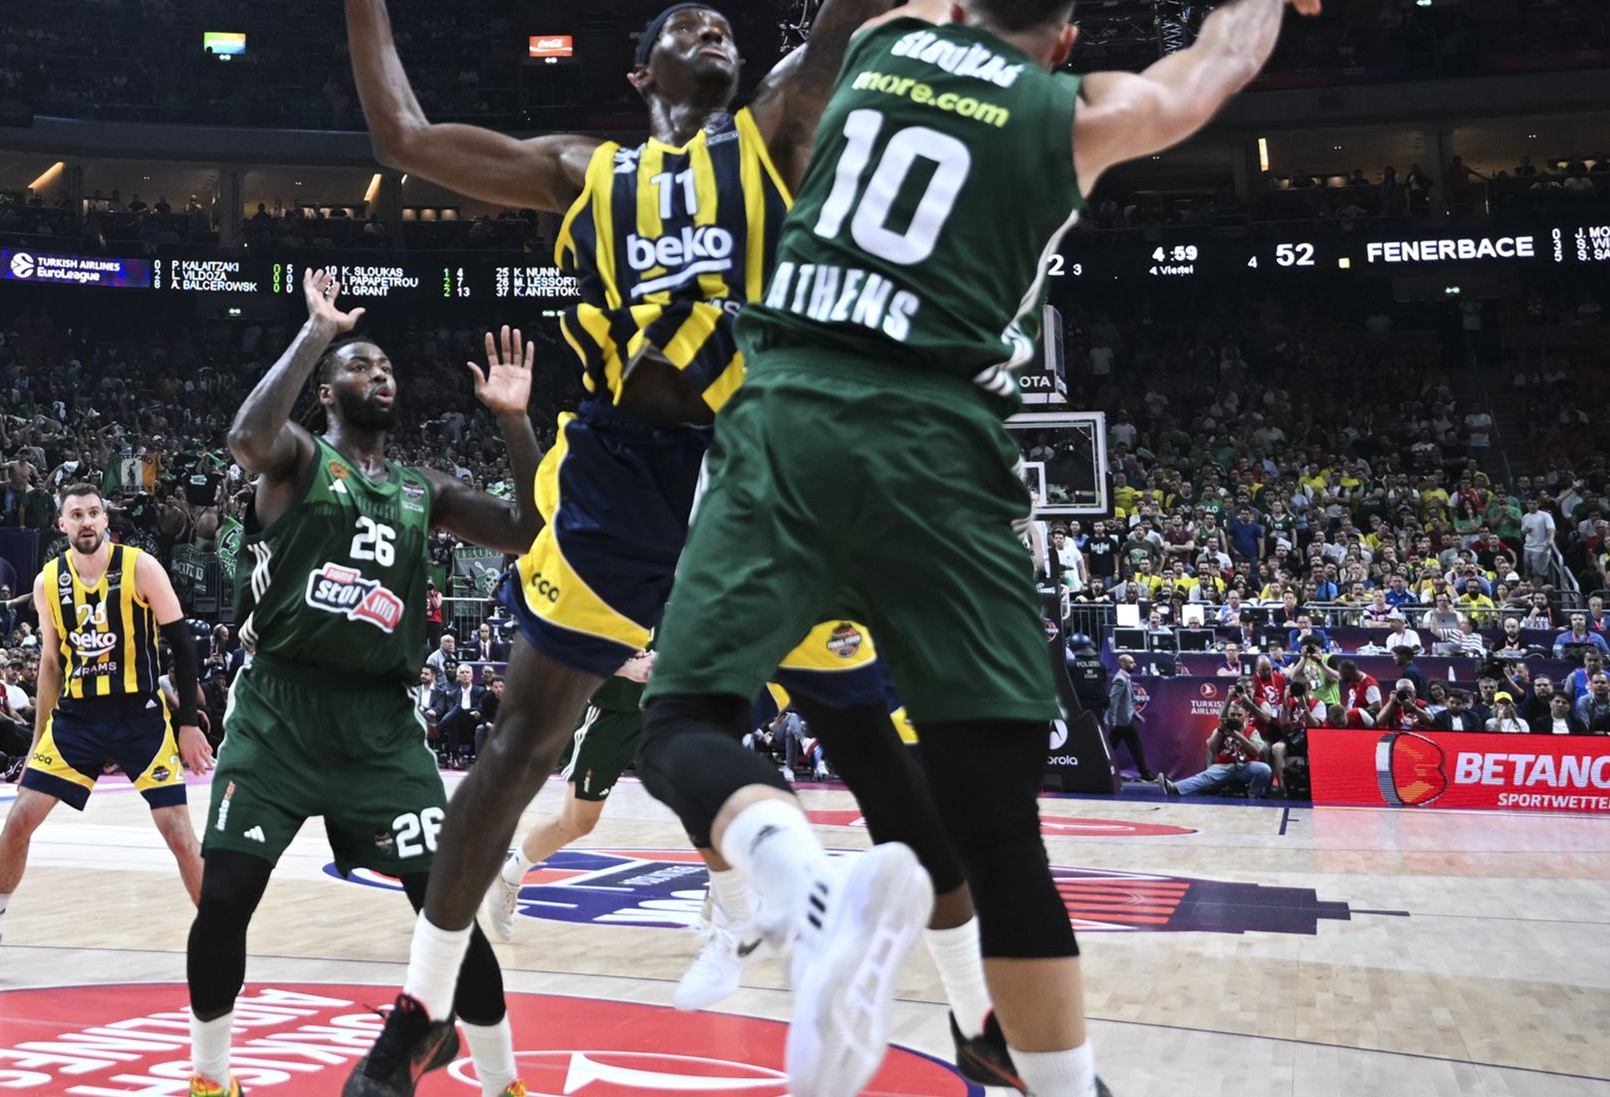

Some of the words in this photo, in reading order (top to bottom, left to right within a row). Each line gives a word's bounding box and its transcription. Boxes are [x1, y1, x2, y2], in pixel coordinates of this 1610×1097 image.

[852, 71, 1010, 128] more.com
[650, 167, 698, 219] 11
[814, 108, 972, 265] 10
[1552, 227, 1561, 240] 0
[1574, 226, 1586, 239] J.
[626, 226, 733, 271] beko
[1366, 236, 1535, 263] FENERBACE
[1553, 239, 1561, 250] 3
[1276, 243, 1315, 266] 52
[37, 256, 77, 270] TURKISH
[79, 259, 121, 272] AIRLINES
[154, 259, 161, 270] 0
[171, 260, 180, 270] P.
[182, 261, 239, 272] KALAITZAKI
[273, 263, 281, 274] 0
[286, 264, 294, 274] 5
[1247, 256, 1257, 268] 4
[36, 268, 100, 283] EuroLeague
[154, 269, 161, 279] 2
[183, 271, 228, 281] VILDOZA
[273, 273, 280, 283] 0
[286, 273, 294, 283] 0
[325, 266, 338, 276] 10
[354, 267, 404, 278] SLOUKAS
[456, 267, 464, 277] 4
[495, 267, 509, 277] 25
[526, 267, 560, 277] NUNN
[1073, 263, 1082, 276] 3
[1149, 266, 1158, 276] 4
[273, 283, 280, 293] 0
[286, 283, 294, 293] 0
[350, 276, 419, 288] PAPAPETROU
[443, 277, 450, 287] 2
[456, 277, 463, 287] 7
[527, 277, 577, 287] LESSORT
[352, 286, 390, 297] GRANT
[443, 287, 450, 297] 2
[456, 287, 471, 297] 13
[495, 287, 509, 297] 37
[764, 261, 920, 342] ATHENS
[349, 515, 396, 567] 26
[69, 630, 117, 649] beko
[82, 661, 117, 675] RAMS
[1191, 699, 1224, 708] TURKIS
[1497, 793, 1610, 809] SPORTWETTE
[392, 806, 445, 858] 26
